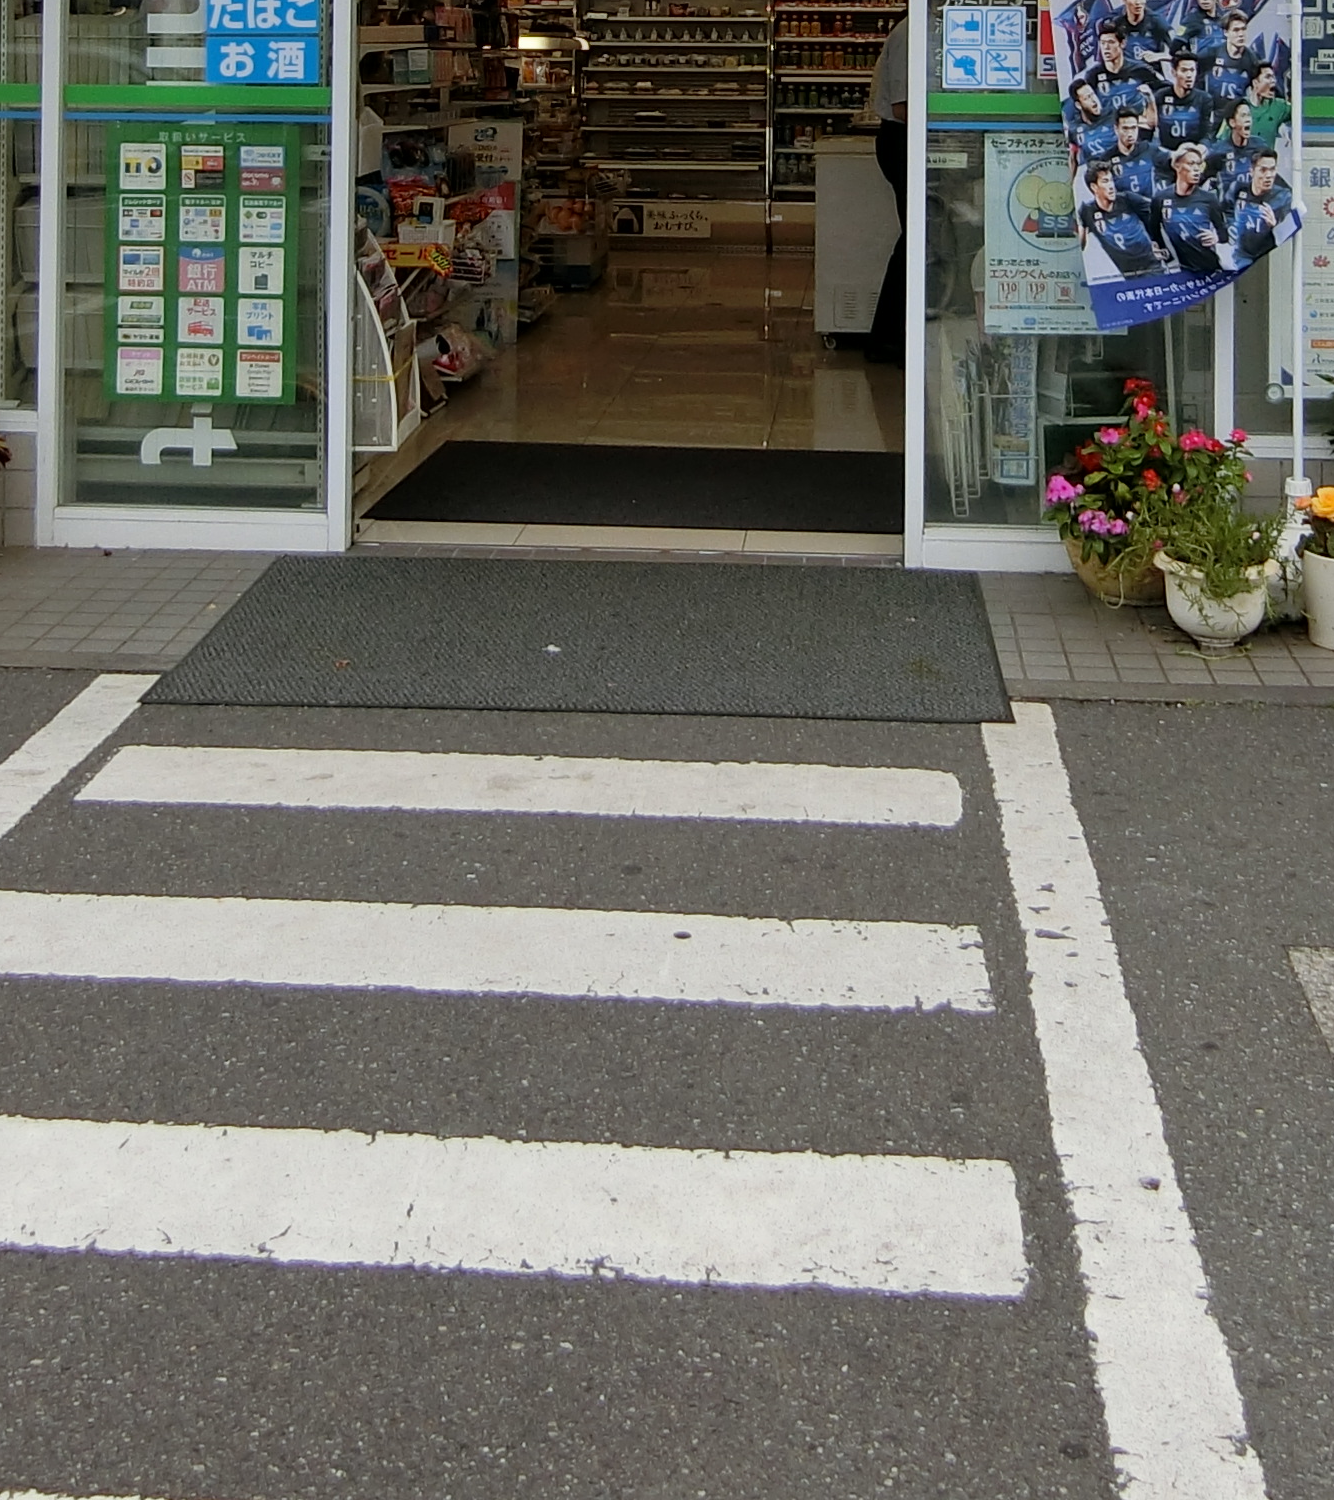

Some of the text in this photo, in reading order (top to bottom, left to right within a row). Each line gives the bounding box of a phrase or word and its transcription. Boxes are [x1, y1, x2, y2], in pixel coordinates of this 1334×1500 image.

[219, 41, 306, 80] お酒
[158, 132, 247, 143] 取扱いサービス
[1043, 215, 1069, 228] SS
[187, 263, 217, 278] 銀行
[187, 281, 216, 291] ATM
[1001, 282, 1017, 292] 110
[1029, 282, 1045, 292] 119
[187, 308, 216, 316] サービス
[246, 312, 275, 320] プリント
